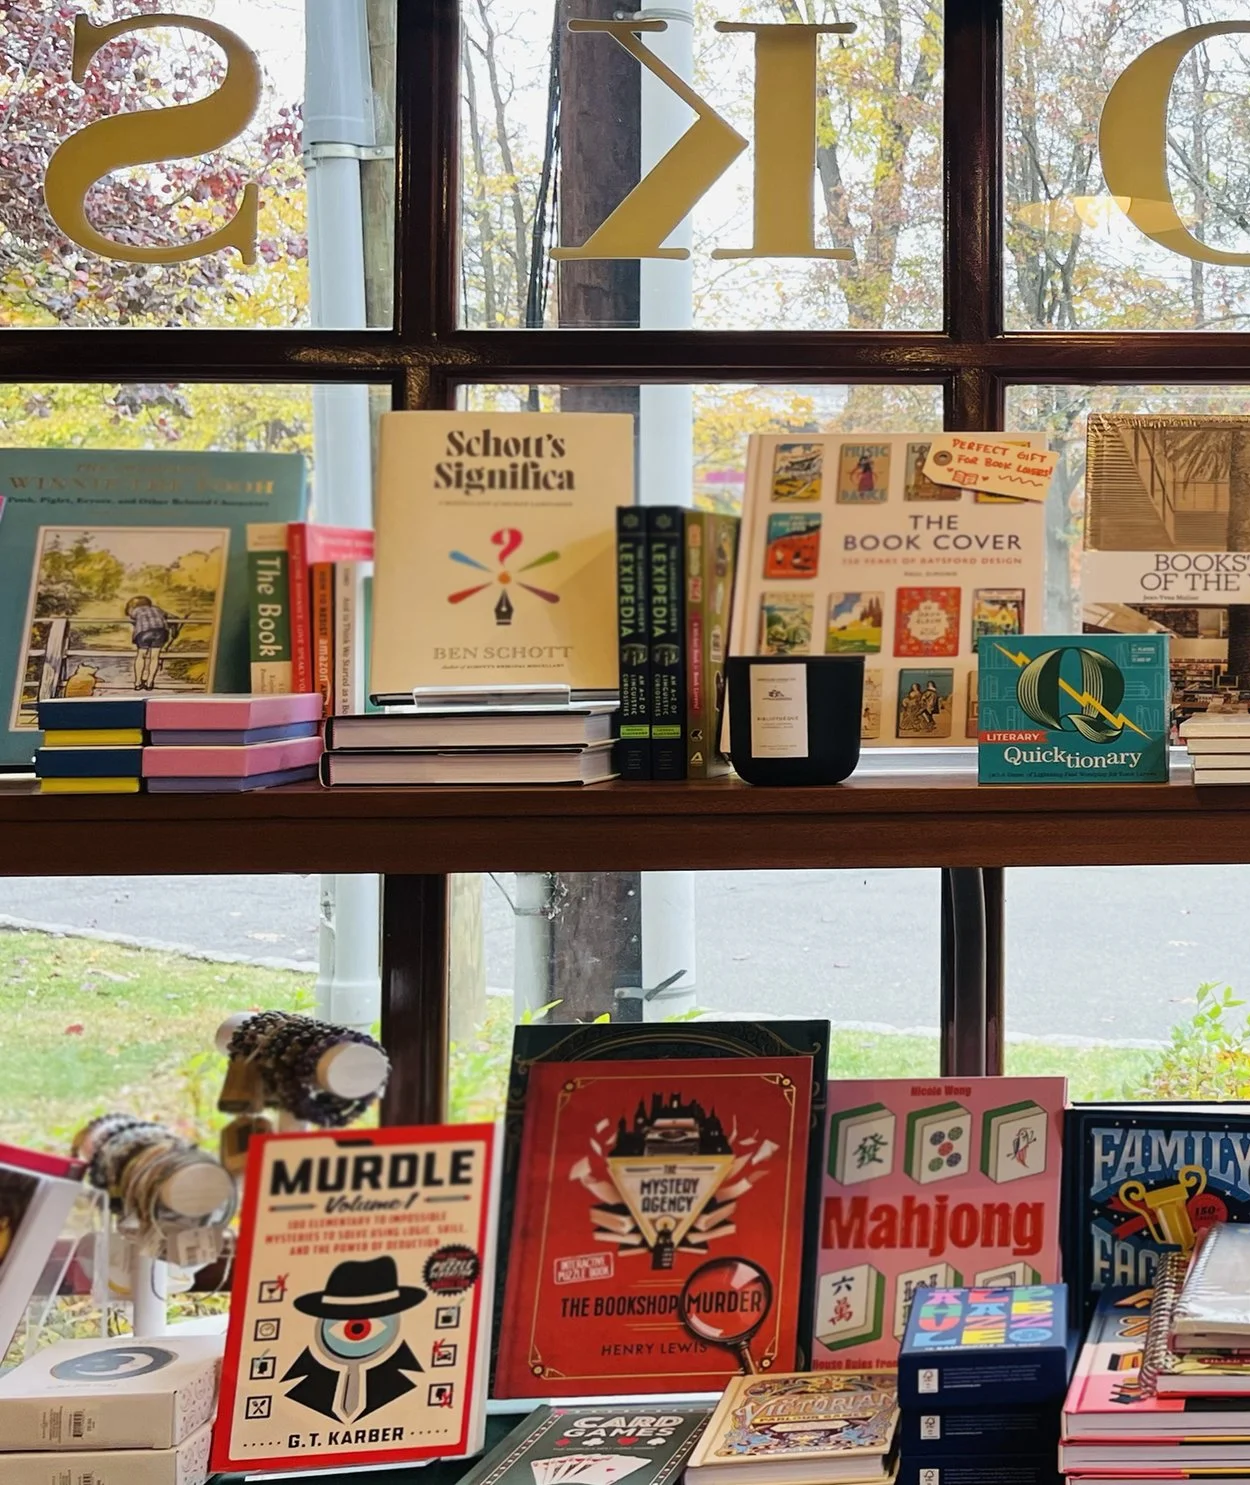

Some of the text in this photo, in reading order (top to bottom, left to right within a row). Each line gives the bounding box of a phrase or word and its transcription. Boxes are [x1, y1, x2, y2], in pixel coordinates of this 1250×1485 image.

[446, 429, 566, 458] Schott's
[952, 438, 1048, 464] PERFECT GIFT
[957, 454, 1013, 470] FOR BOOK
[434, 461, 576, 496] Significa
[909, 515, 959, 531] THE
[843, 534, 1022, 551] BOOK COVER
[256, 556, 282, 596] The
[1140, 573, 1178, 591] OF
[1184, 573, 1240, 591] THE
[619, 543, 635, 638] LEXIPEDIA
[651, 543, 668, 638] LEXIPEDIA
[257, 603, 284, 657] Book
[343, 623, 351, 645] Think
[318, 638, 329, 682] amazon
[343, 646, 351, 658] We
[433, 646, 573, 660] BEN SCHOTT
[342, 660, 350, 686] Started
[342, 689, 348, 697] as
[986, 732, 1041, 742] LITERARY
[1004, 746, 1143, 769] Quicktionary
[911, 1085, 972, 1098] Nicole Wong
[270, 1150, 475, 1196] MURDLE
[664, 1165, 677, 1174] THE
[640, 1178, 700, 1196] MYSTERY
[324, 1194, 400, 1214] Volume
[641, 1195, 696, 1213] AGENCY
[308, 1211, 447, 1229] ELEMENTARY TO IMPOSSIBLE
[821, 1194, 1046, 1257] Mahjong
[265, 1228, 400, 1244] MYSTERIES TO SOLVE USING
[289, 1238, 440, 1256] AND THE POWER OF DEDUCTION
[557, 1267, 586, 1283] PUZZLE
[561, 1290, 763, 1318] THE BOOKSHOP MURDER
[601, 1340, 709, 1357] HENRY LEWIS
[812, 1358, 874, 1369] House Rules
[736, 1391, 898, 1426] VICTORIAN
[573, 1416, 685, 1429] CARD
[759, 1415, 820, 1423] PARLOUR
[288, 1427, 405, 1448] G.T. KARBER
[563, 1427, 677, 1437] GAMES
